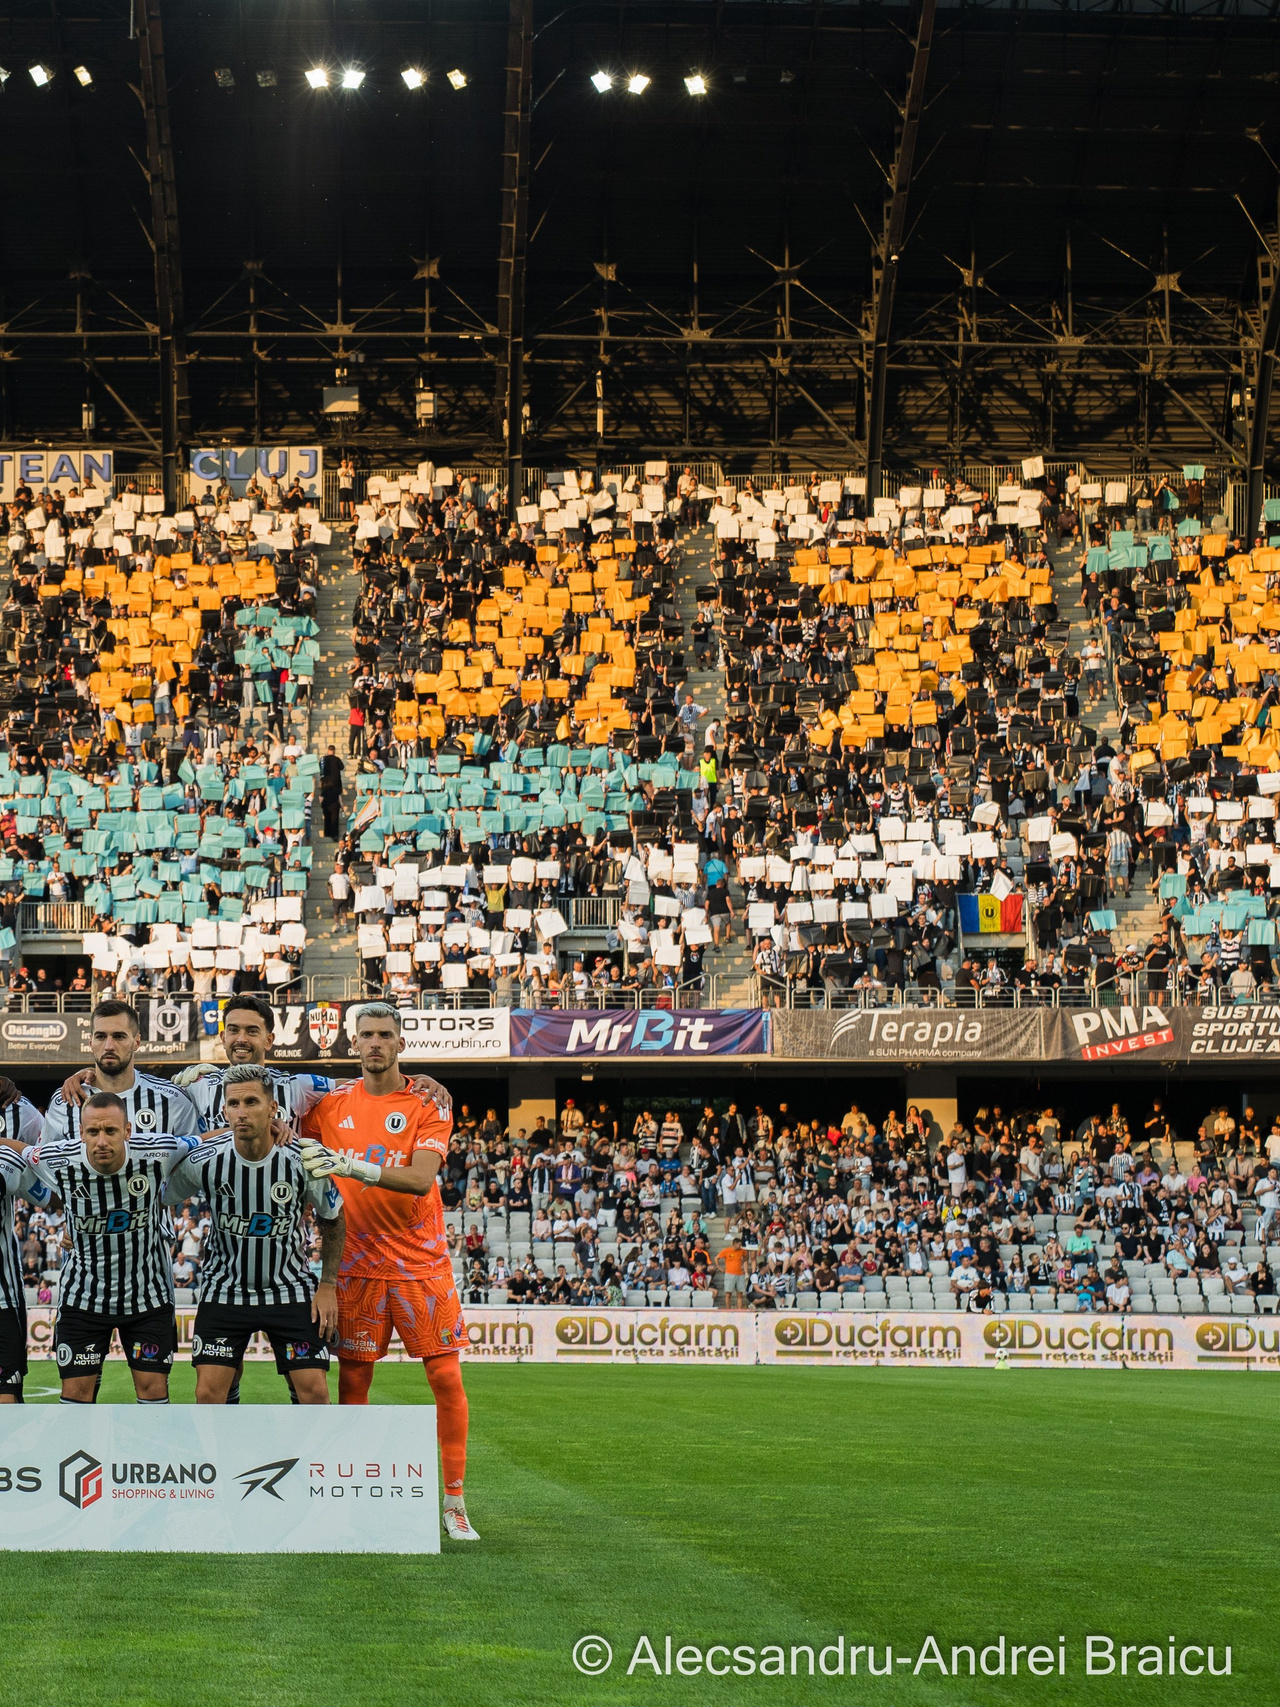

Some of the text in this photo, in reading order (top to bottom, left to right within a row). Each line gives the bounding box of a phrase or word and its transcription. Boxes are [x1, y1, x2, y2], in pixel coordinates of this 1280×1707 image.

[191, 449, 319, 481] CLUJ
[310, 1010, 338, 1022] NUMAI
[402, 1017, 495, 1031] OTORS
[566, 1009, 714, 1051] MrBit
[861, 1010, 982, 1048] Terapia
[1072, 1006, 1170, 1045] PMA
[7, 1042, 61, 1051] Better Everyday
[407, 1037, 502, 1049] www.rubin.ro
[876, 1049, 898, 1057] SUN
[899, 1049, 941, 1057] PHARMA
[942, 1049, 982, 1059] company
[140, 1114, 151, 1123] U
[390, 1117, 401, 1129] U
[133, 1180, 144, 1191] U
[277, 1187, 287, 1199] U
[74, 1209, 150, 1235] MrBit
[219, 1212, 293, 1238] MrBit
[589, 1317, 739, 1346] Ducfarm
[808, 1319, 962, 1347] Ducfarm
[1018, 1320, 1174, 1350] Ducfarm
[615, 1348, 664, 1359] rețeta
[835, 1349, 885, 1360] rețeta
[1045, 1352, 1096, 1363] rețeta
[111, 1463, 217, 1484] URBANO
[309, 1463, 423, 1478] RUBIN
[111, 1488, 215, 1500] SHOPPING & LIVING
[309, 1486, 424, 1498] MOTORS
